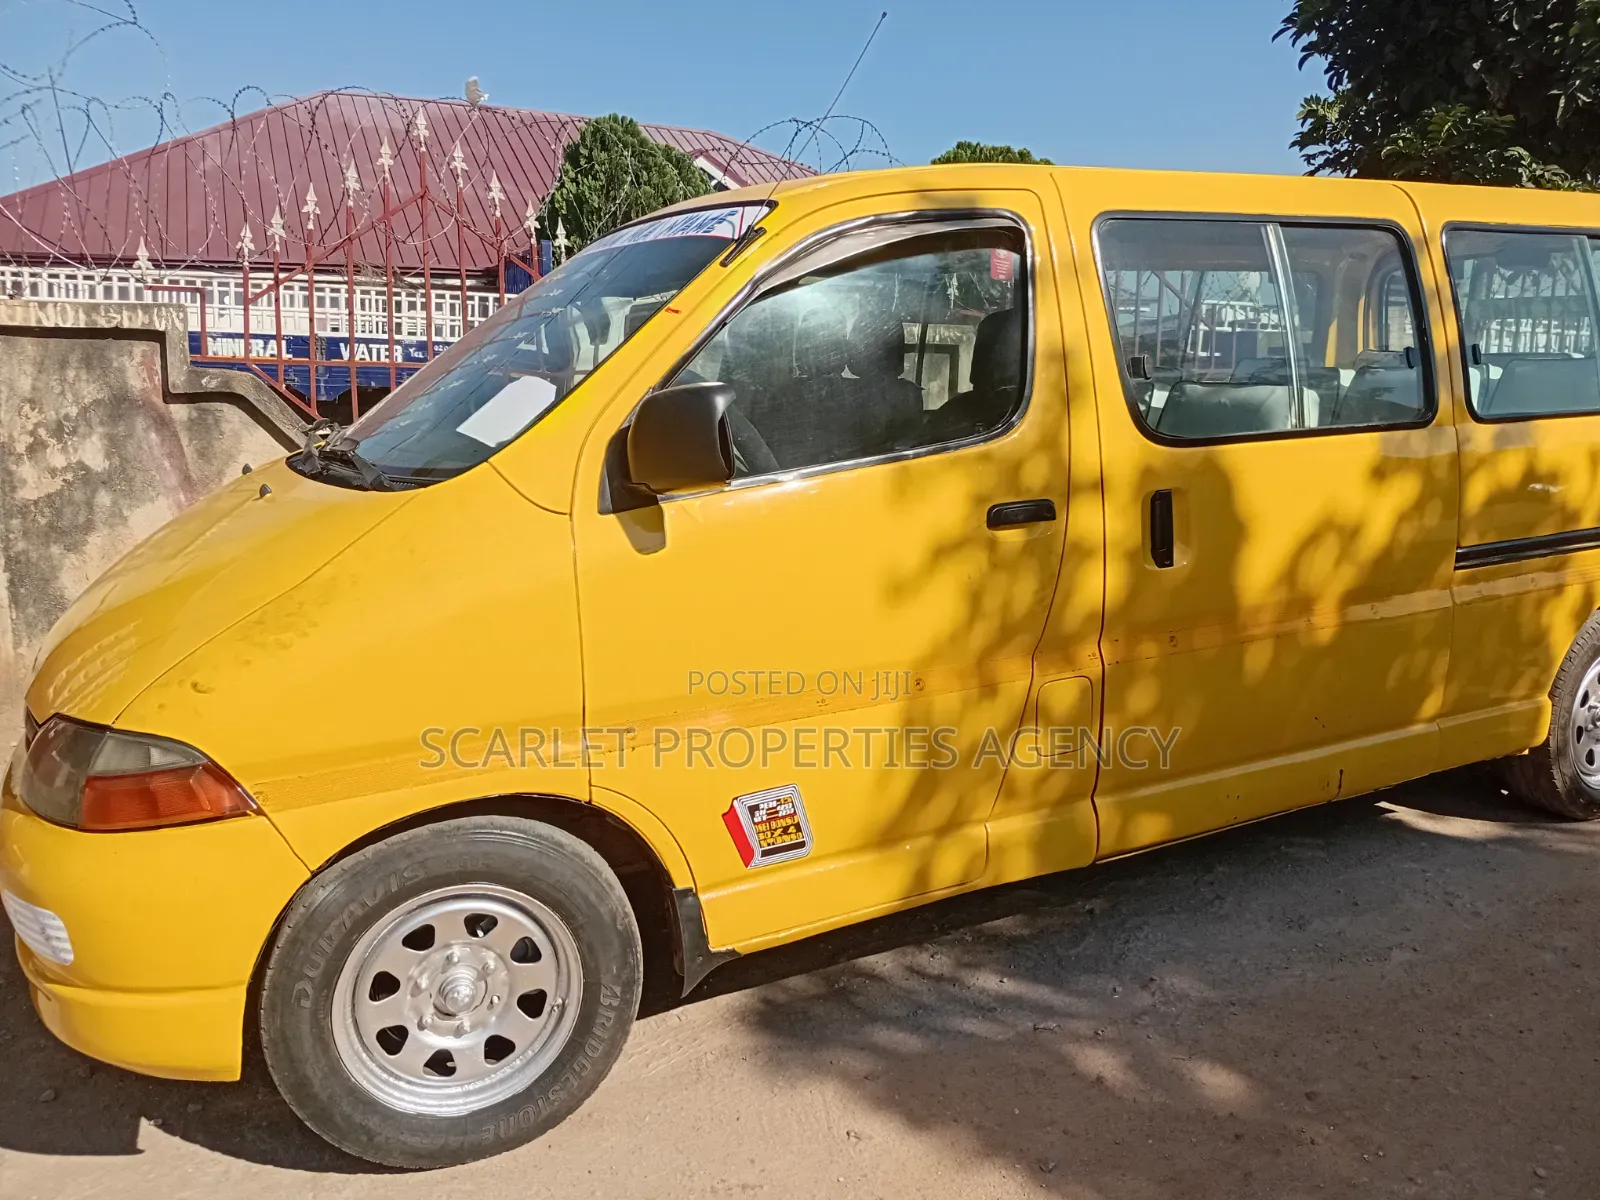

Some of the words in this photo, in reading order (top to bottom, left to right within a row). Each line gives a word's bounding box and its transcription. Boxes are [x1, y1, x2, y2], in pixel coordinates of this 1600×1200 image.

[207, 337, 293, 358] MINRAL
[292, 866, 428, 1008] DURAVIS
[480, 983, 621, 1146] BRIDGESTONE
